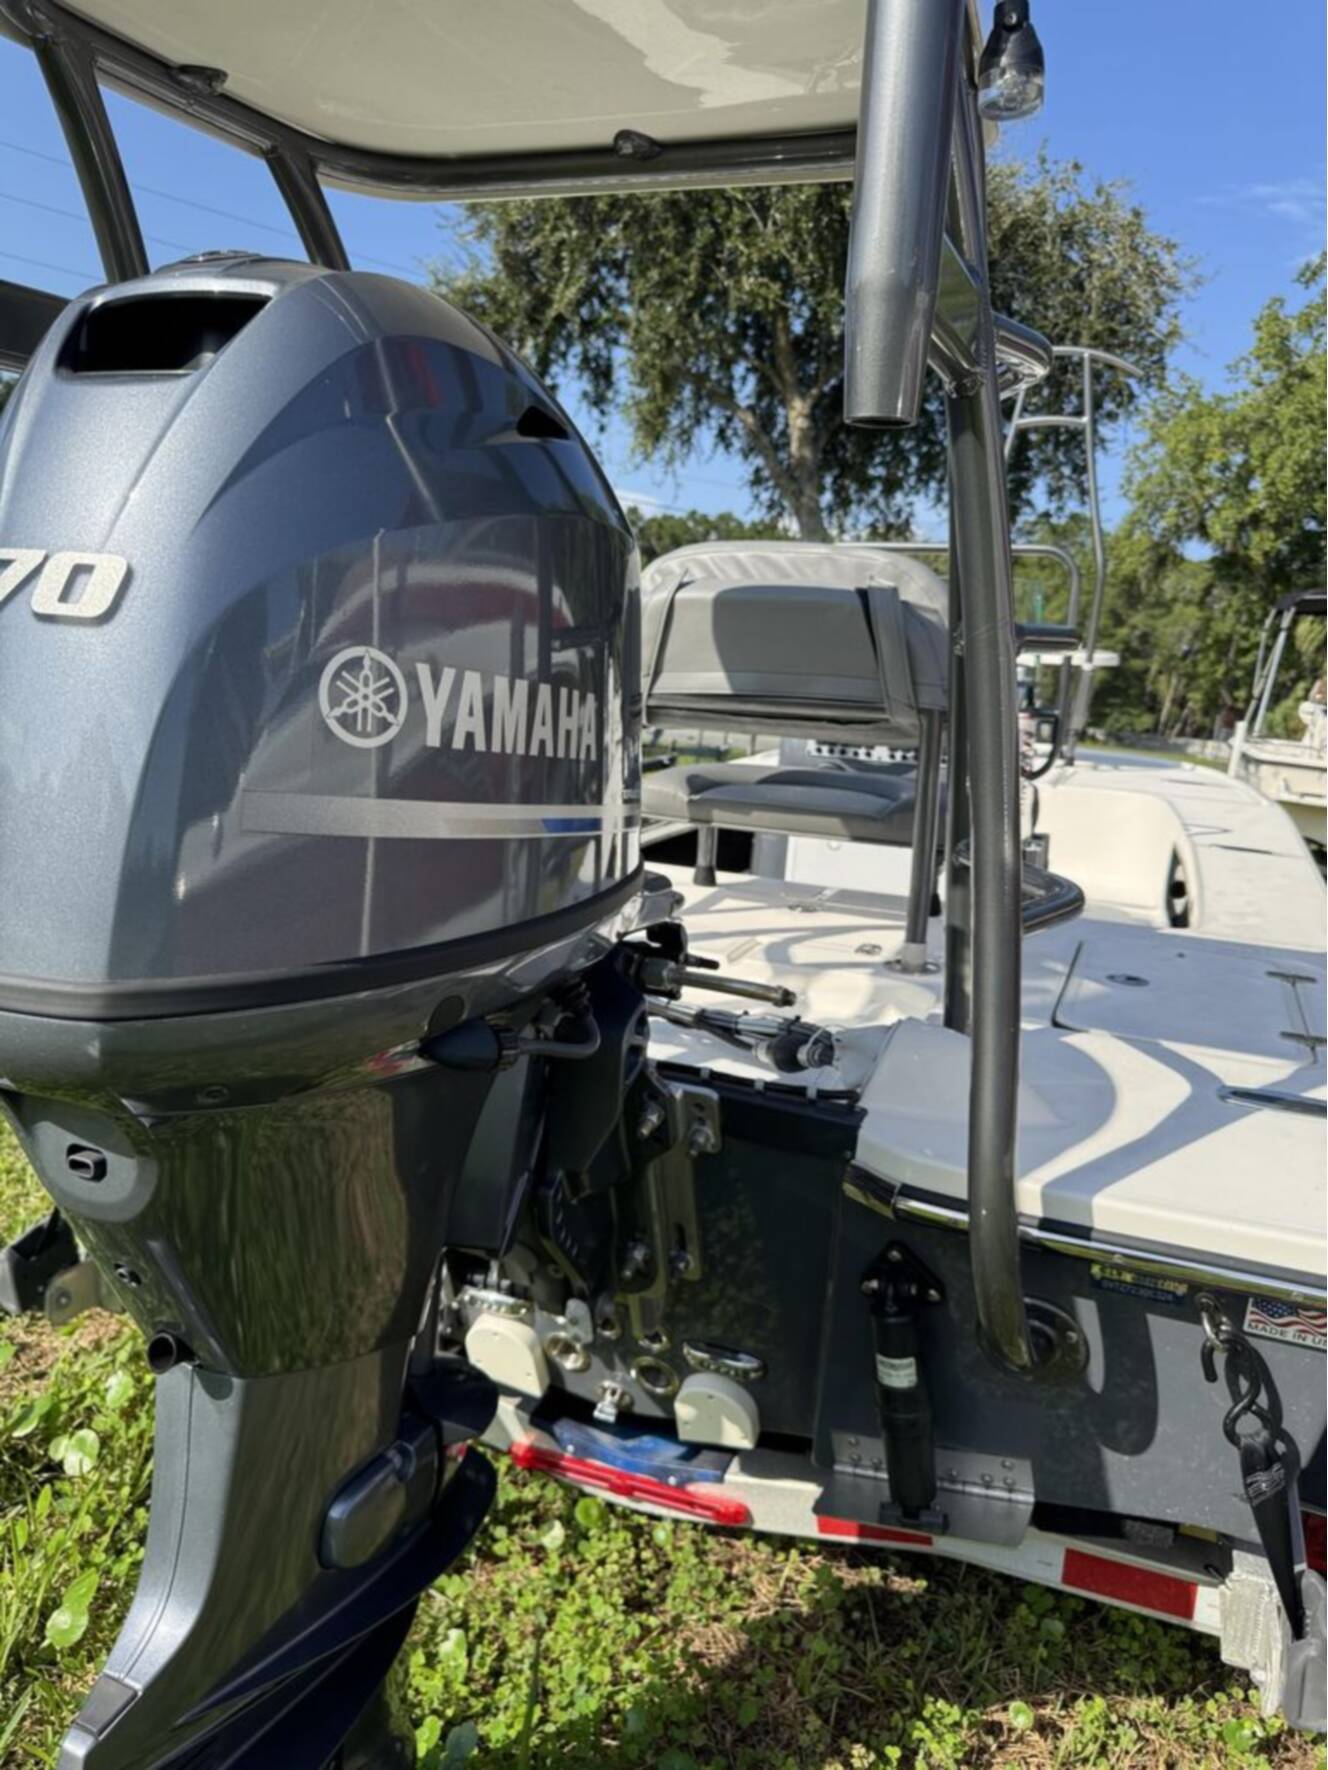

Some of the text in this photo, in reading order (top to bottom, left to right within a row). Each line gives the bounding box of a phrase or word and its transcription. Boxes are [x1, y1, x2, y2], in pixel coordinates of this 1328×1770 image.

[415, 662, 597, 761] YAMAHA
[1247, 1322, 1288, 1338] MADE
[1292, 1331, 1307, 1342] IN
